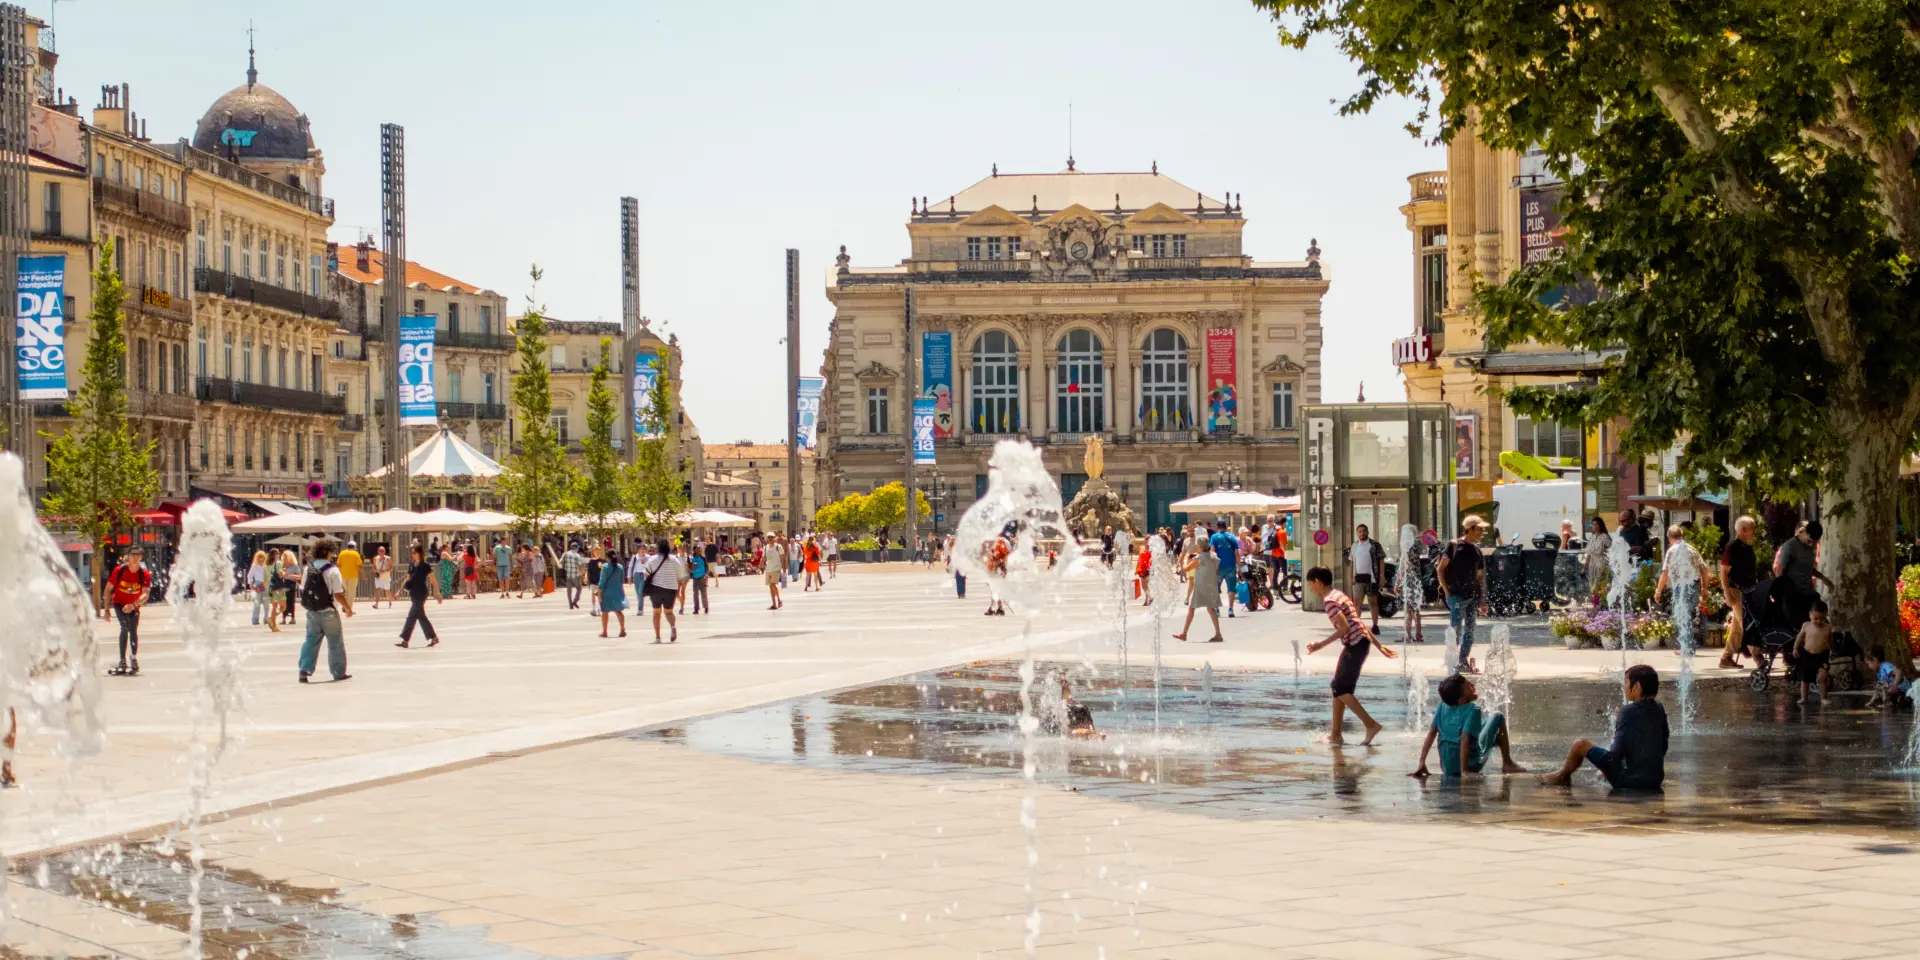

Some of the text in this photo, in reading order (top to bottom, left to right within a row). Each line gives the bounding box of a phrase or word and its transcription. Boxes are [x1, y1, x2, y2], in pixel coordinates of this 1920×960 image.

[1526, 202, 1539, 216] LES
[1526, 217, 1545, 232] PLUS
[1527, 232, 1553, 248] BELLES
[17, 280, 62, 290] Montpellier
[31, 274, 63, 282] Festival
[17, 291, 63, 317] DA
[1309, 418, 1334, 530] Parking
